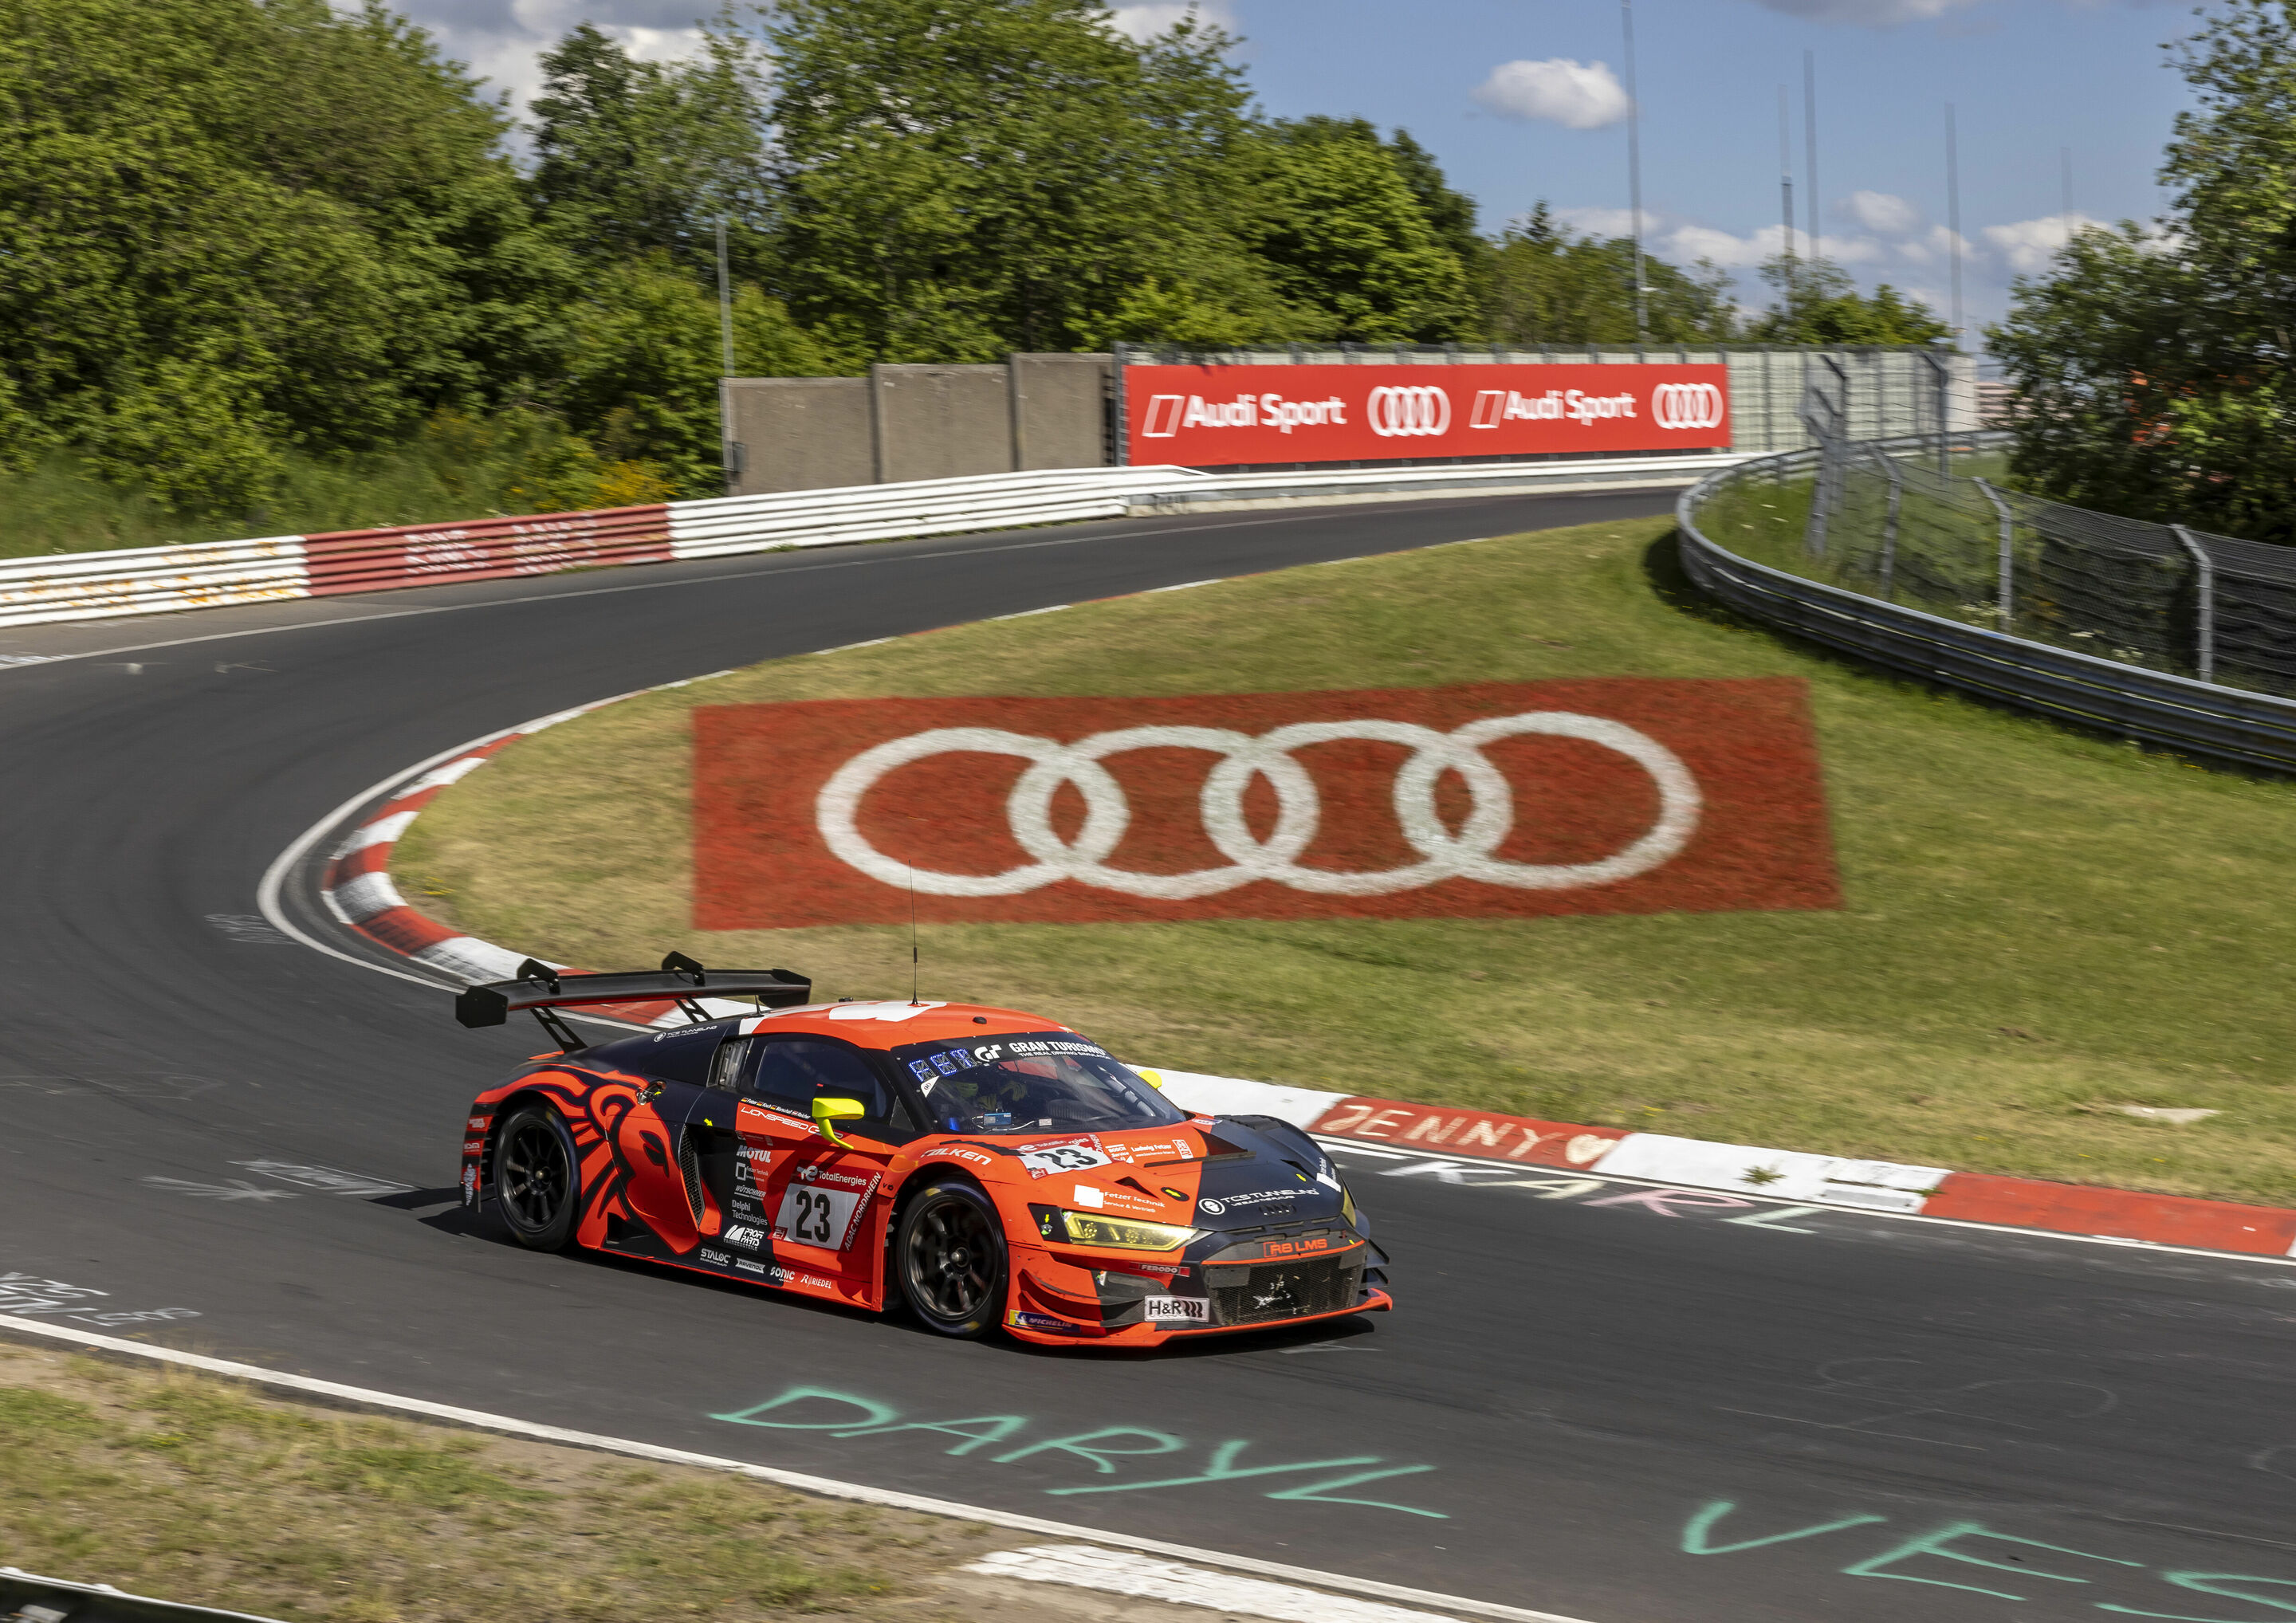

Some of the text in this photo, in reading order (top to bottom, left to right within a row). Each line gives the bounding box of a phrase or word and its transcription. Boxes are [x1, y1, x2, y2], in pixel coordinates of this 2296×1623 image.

[1182, 393, 1348, 434] Audi Sport
[1503, 388, 1637, 426] Audi Sport
[1008, 1041, 1107, 1056] GRAN TURISMO
[741, 1106, 808, 1130] LIONSPEED
[1320, 1104, 1567, 1158] JENNY
[736, 1145, 771, 1163] MOTUL
[920, 1147, 993, 1165] FALKEN
[1035, 1148, 1098, 1169] 23
[819, 1170, 867, 1187] TotalEnergies
[1104, 1191, 1166, 1208] Fetzer Technik
[1220, 1188, 1320, 1203] TCS TUNNELING
[732, 1199, 751, 1212] Delphi
[844, 1172, 883, 1251] ADAC NORDRHEIN
[732, 1209, 768, 1226] Technologies
[796, 1190, 831, 1244] 23
[741, 1235, 760, 1247] PARTS
[744, 1228, 765, 1240] PROFI
[723, 1238, 758, 1252] FAHRZEUGTEILE
[1270, 1238, 1327, 1256] R8 LMS
[700, 1248, 729, 1263] STALOC
[739, 1260, 763, 1271] RAVENOL
[769, 1266, 796, 1281] SONIC
[1141, 1264, 1178, 1274] FERODO
[812, 1276, 832, 1289] RIEDEL
[1149, 1299, 1181, 1315] H&R
[708, 1385, 1450, 1519] DARYL
